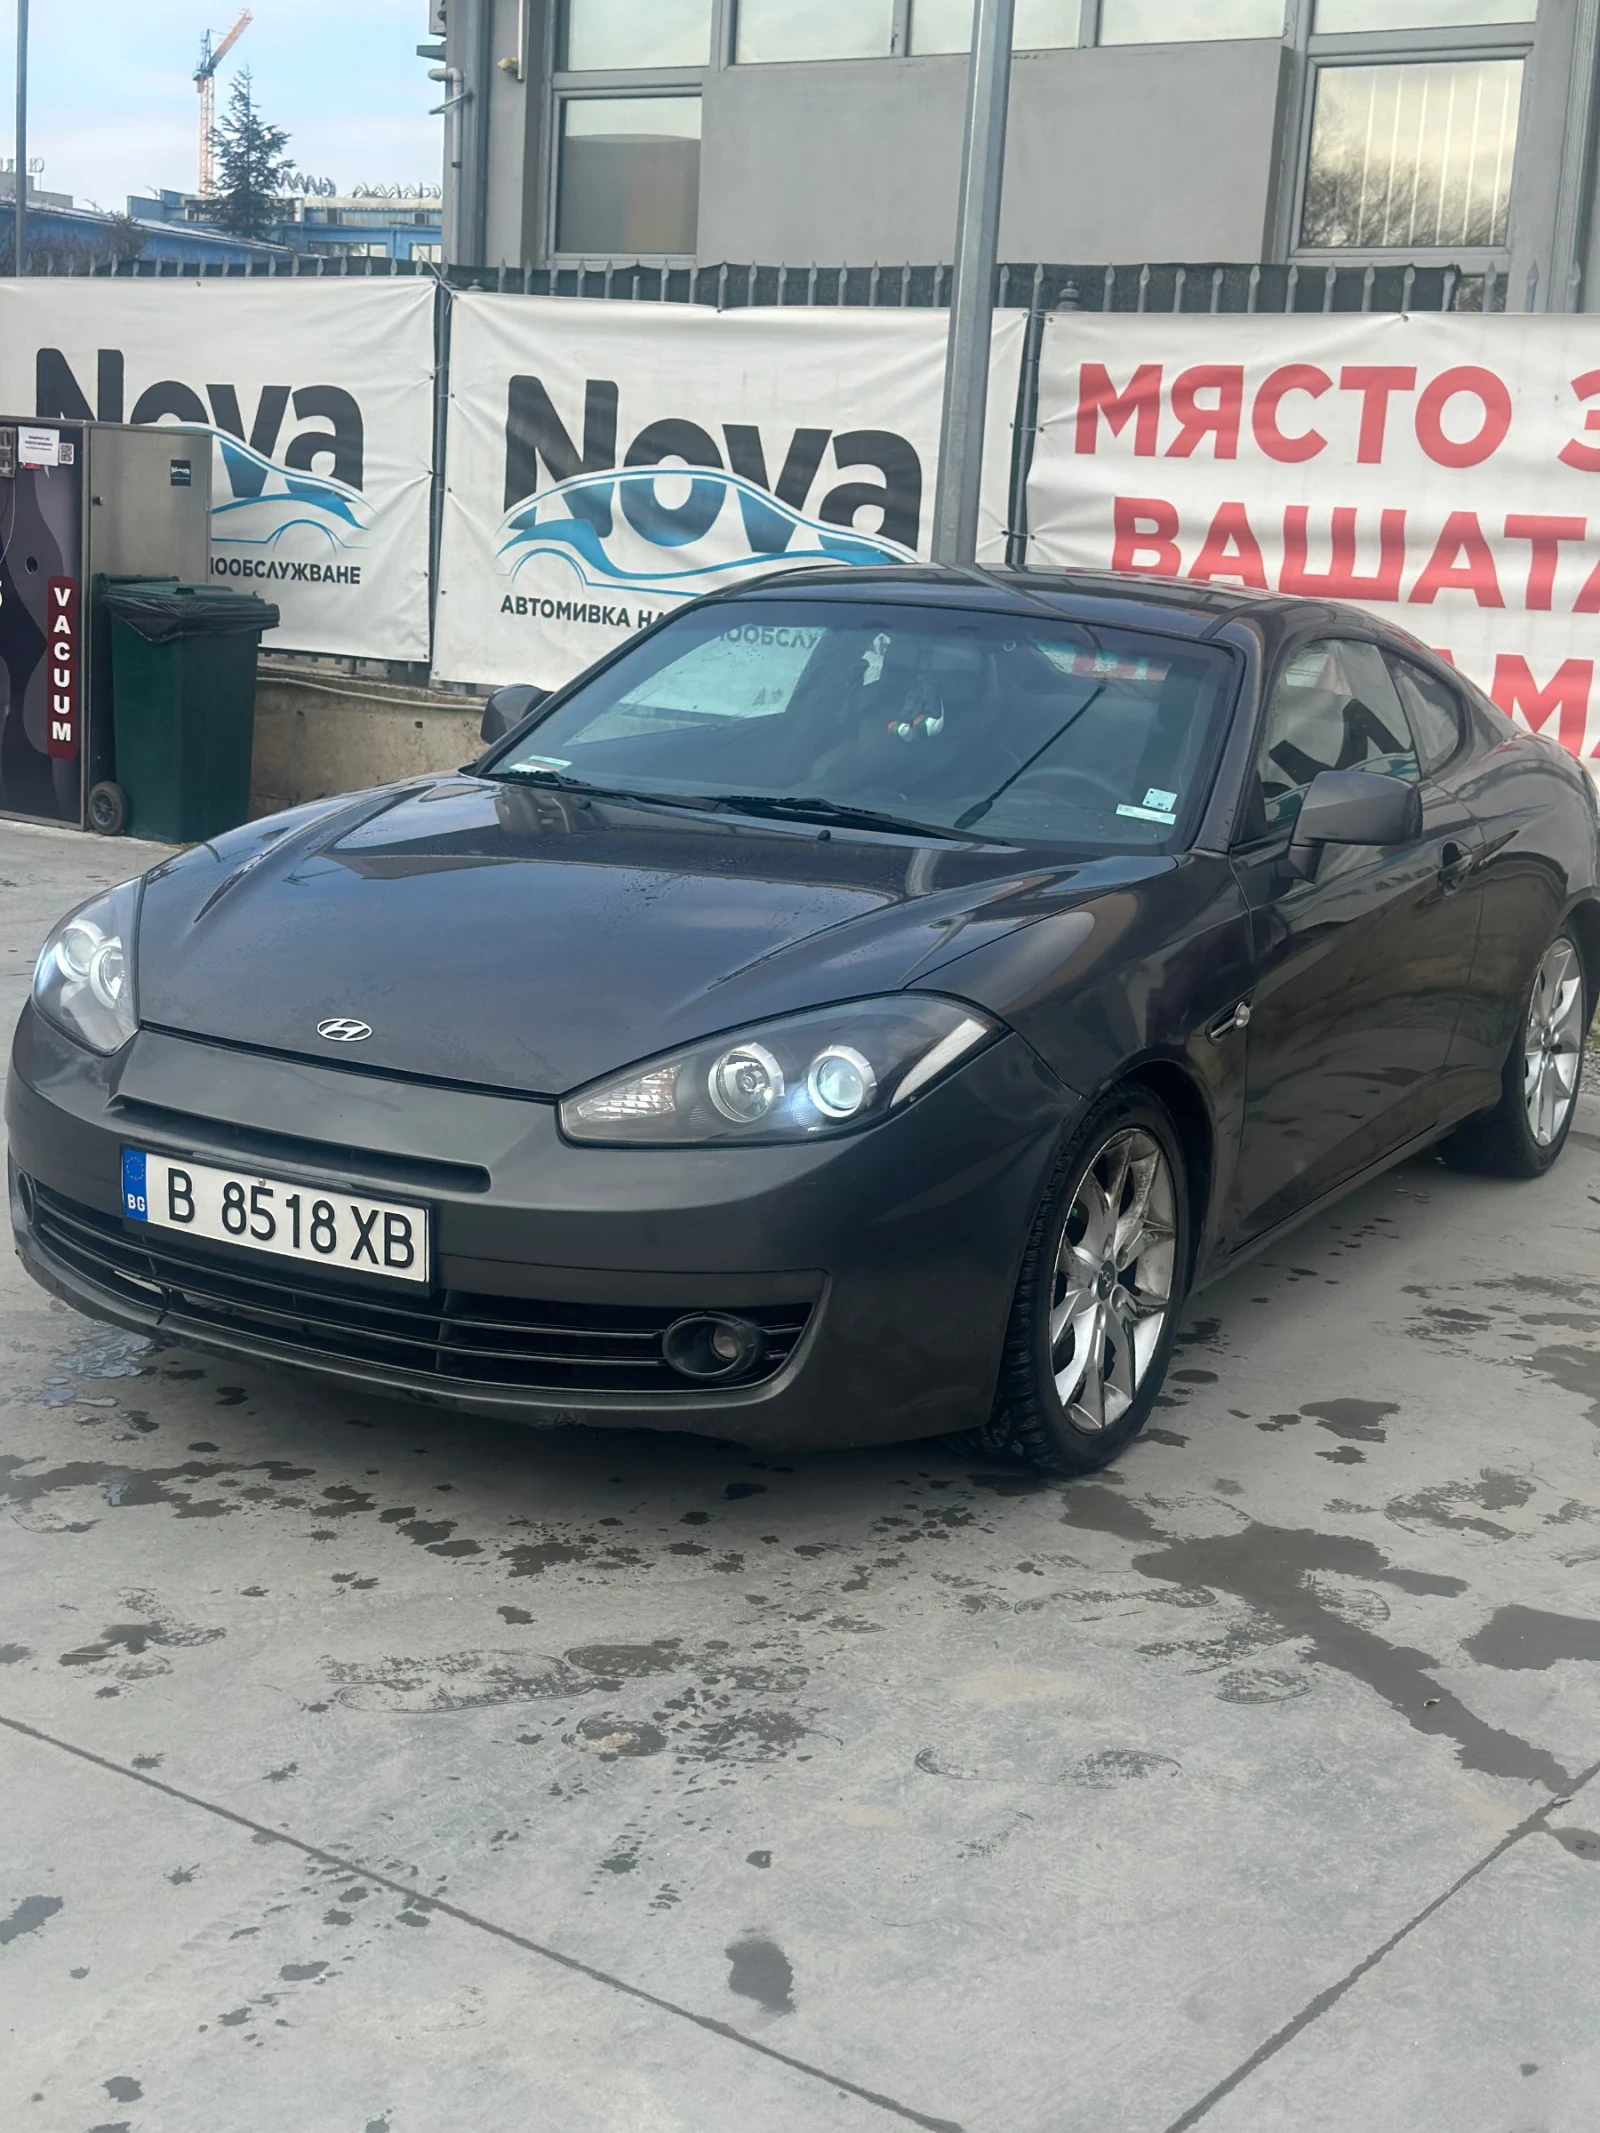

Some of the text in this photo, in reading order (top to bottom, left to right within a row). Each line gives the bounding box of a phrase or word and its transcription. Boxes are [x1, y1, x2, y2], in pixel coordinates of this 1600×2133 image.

[504, 375, 922, 556] Nova
[1074, 363, 1512, 469] МЯСТО
[52, 587, 72, 741] VACUUM
[501, 594, 631, 628] АВТОМИВКА
[720, 625, 821, 649] ООБСЛУ
[127, 1193, 146, 1212] BG
[168, 1167, 415, 1269] B 8518 XB
